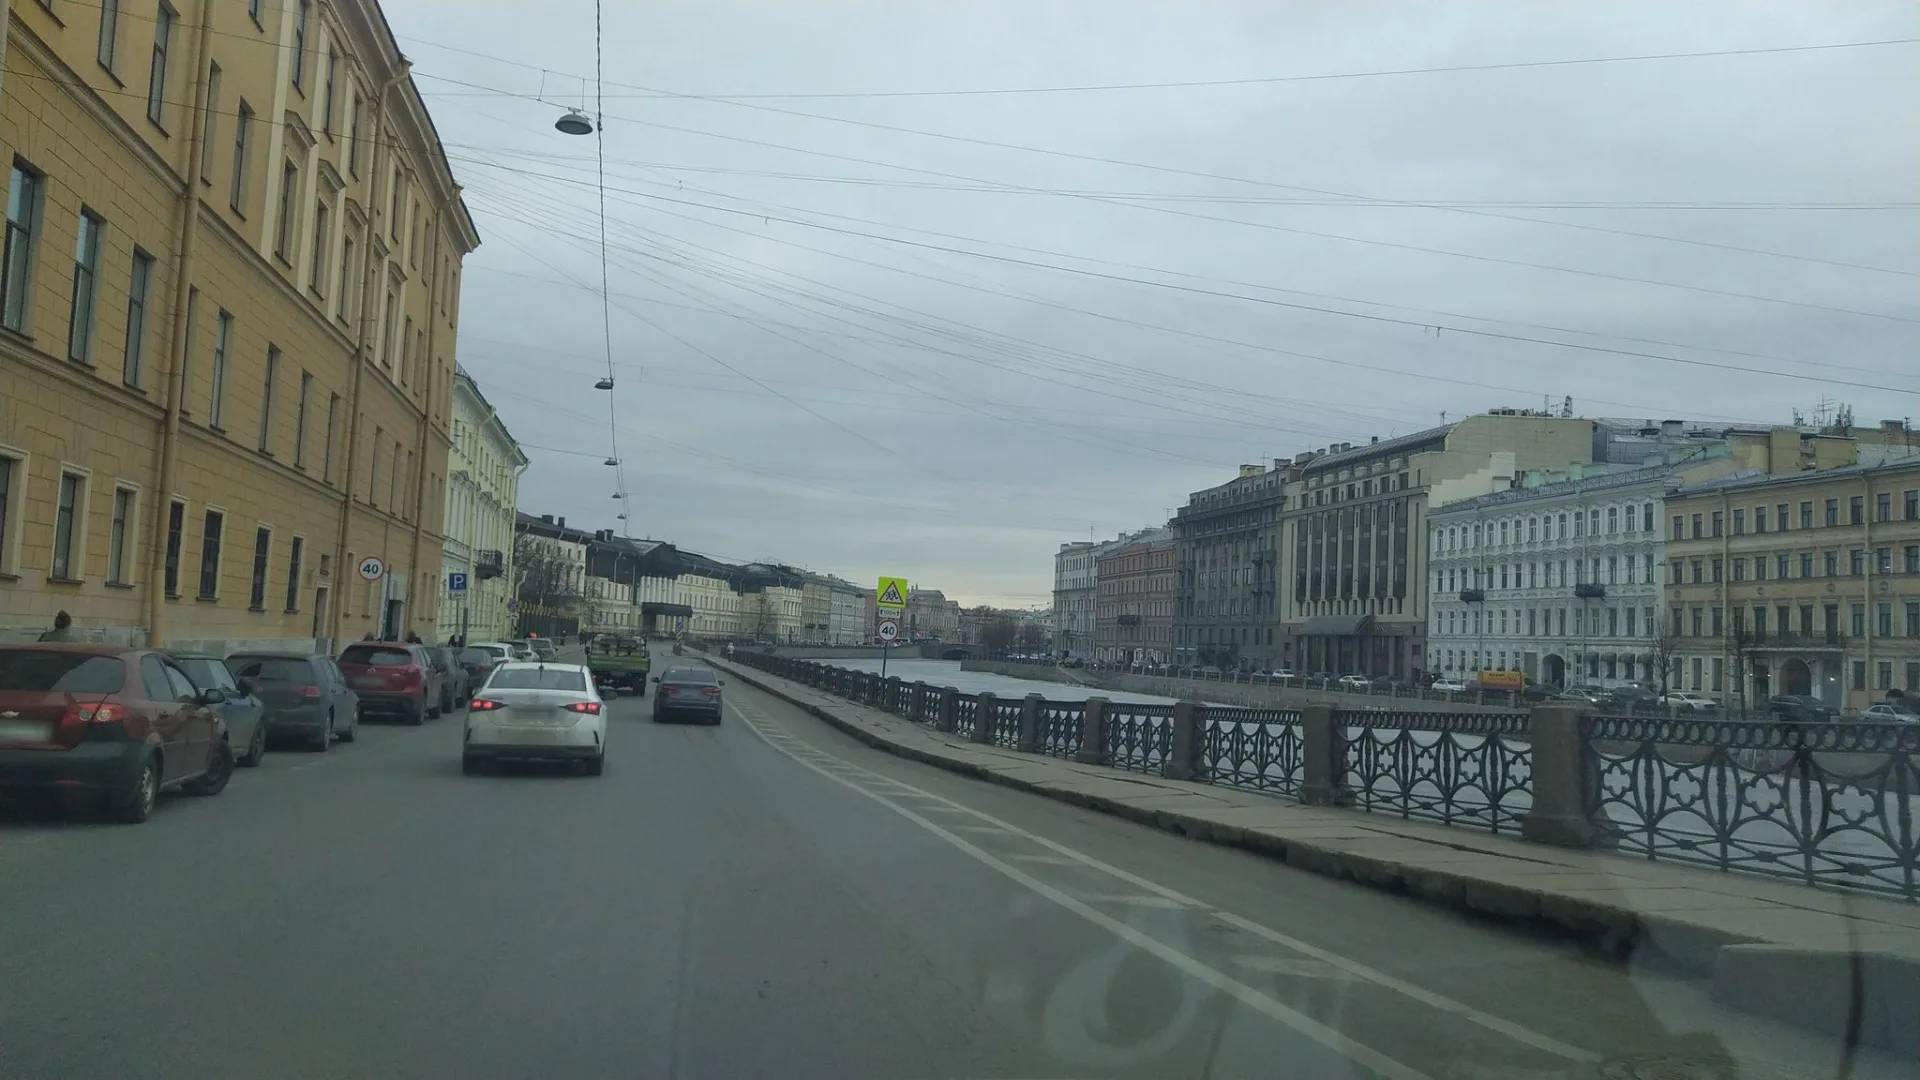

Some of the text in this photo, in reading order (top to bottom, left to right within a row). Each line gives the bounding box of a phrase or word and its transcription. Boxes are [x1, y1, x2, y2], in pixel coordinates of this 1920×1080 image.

[362, 563, 379, 574] 40
[453, 574, 464, 588] P
[881, 625, 895, 636] 40
